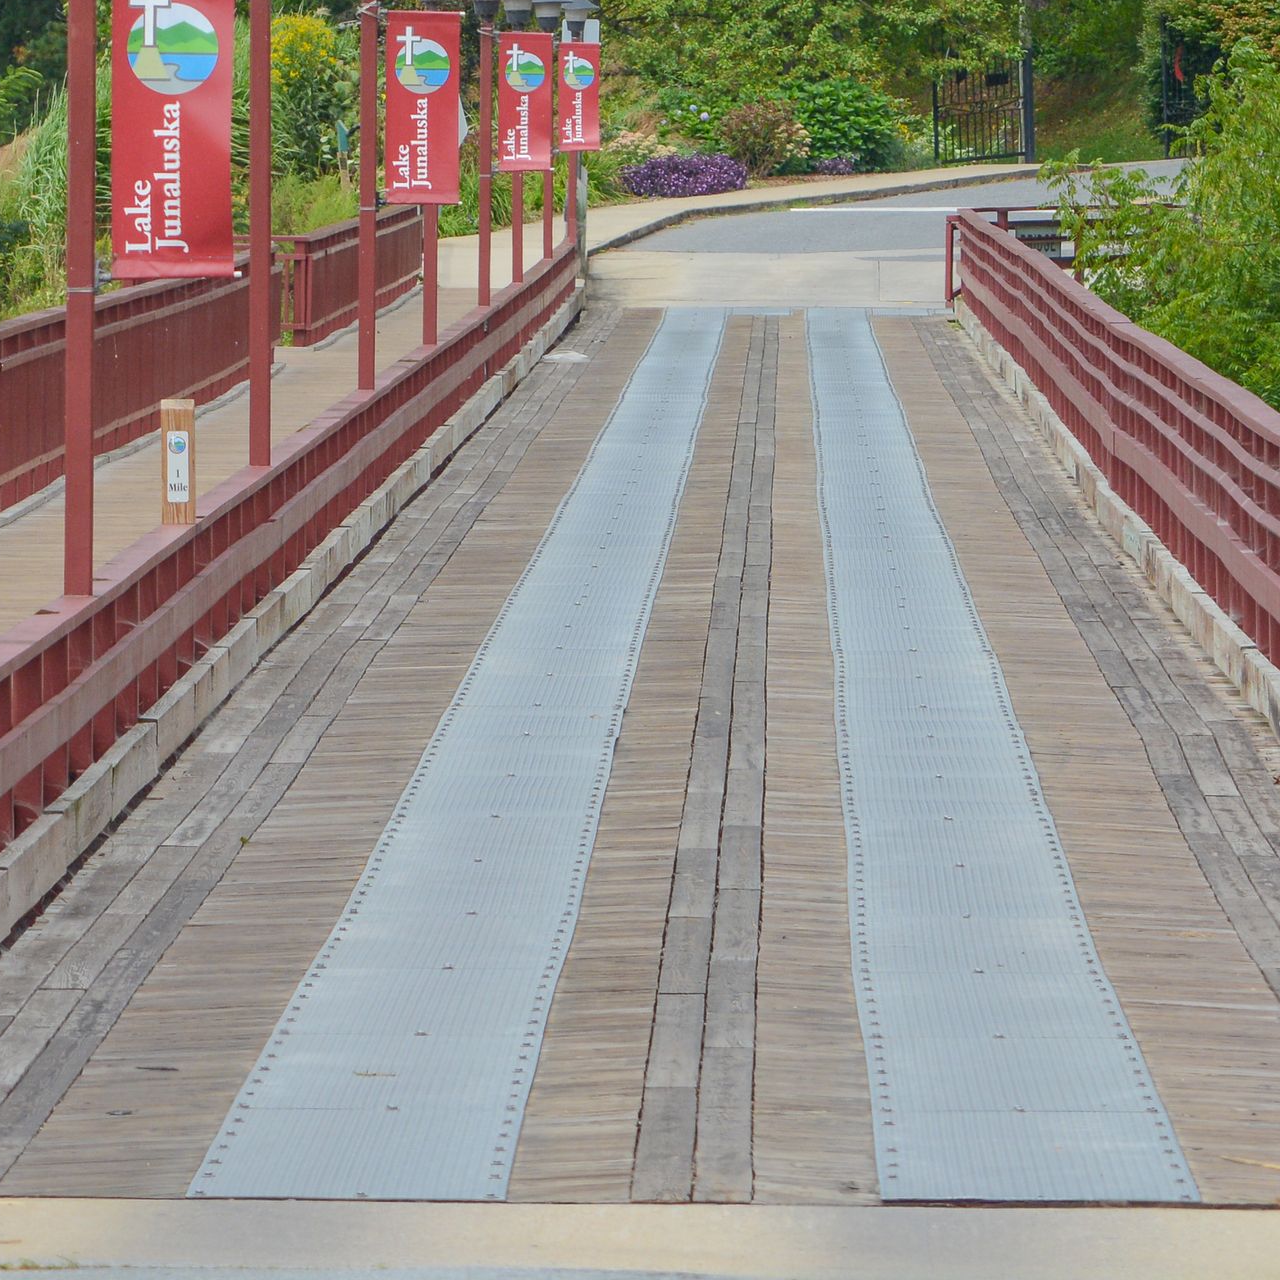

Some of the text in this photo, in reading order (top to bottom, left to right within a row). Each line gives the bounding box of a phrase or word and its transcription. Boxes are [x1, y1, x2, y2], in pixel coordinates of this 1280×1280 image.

[516, 94, 531, 160] Junaluska
[562, 118, 572, 143] Lake
[572, 91, 584, 143] Junaluska
[392, 144, 410, 190] Lake
[410, 97, 432, 190] Junaluska
[503, 128, 516, 160] Lake
[153, 100, 189, 254] Junaluska
[124, 180, 152, 254] Lake
[169, 483, 188, 492] Mile
